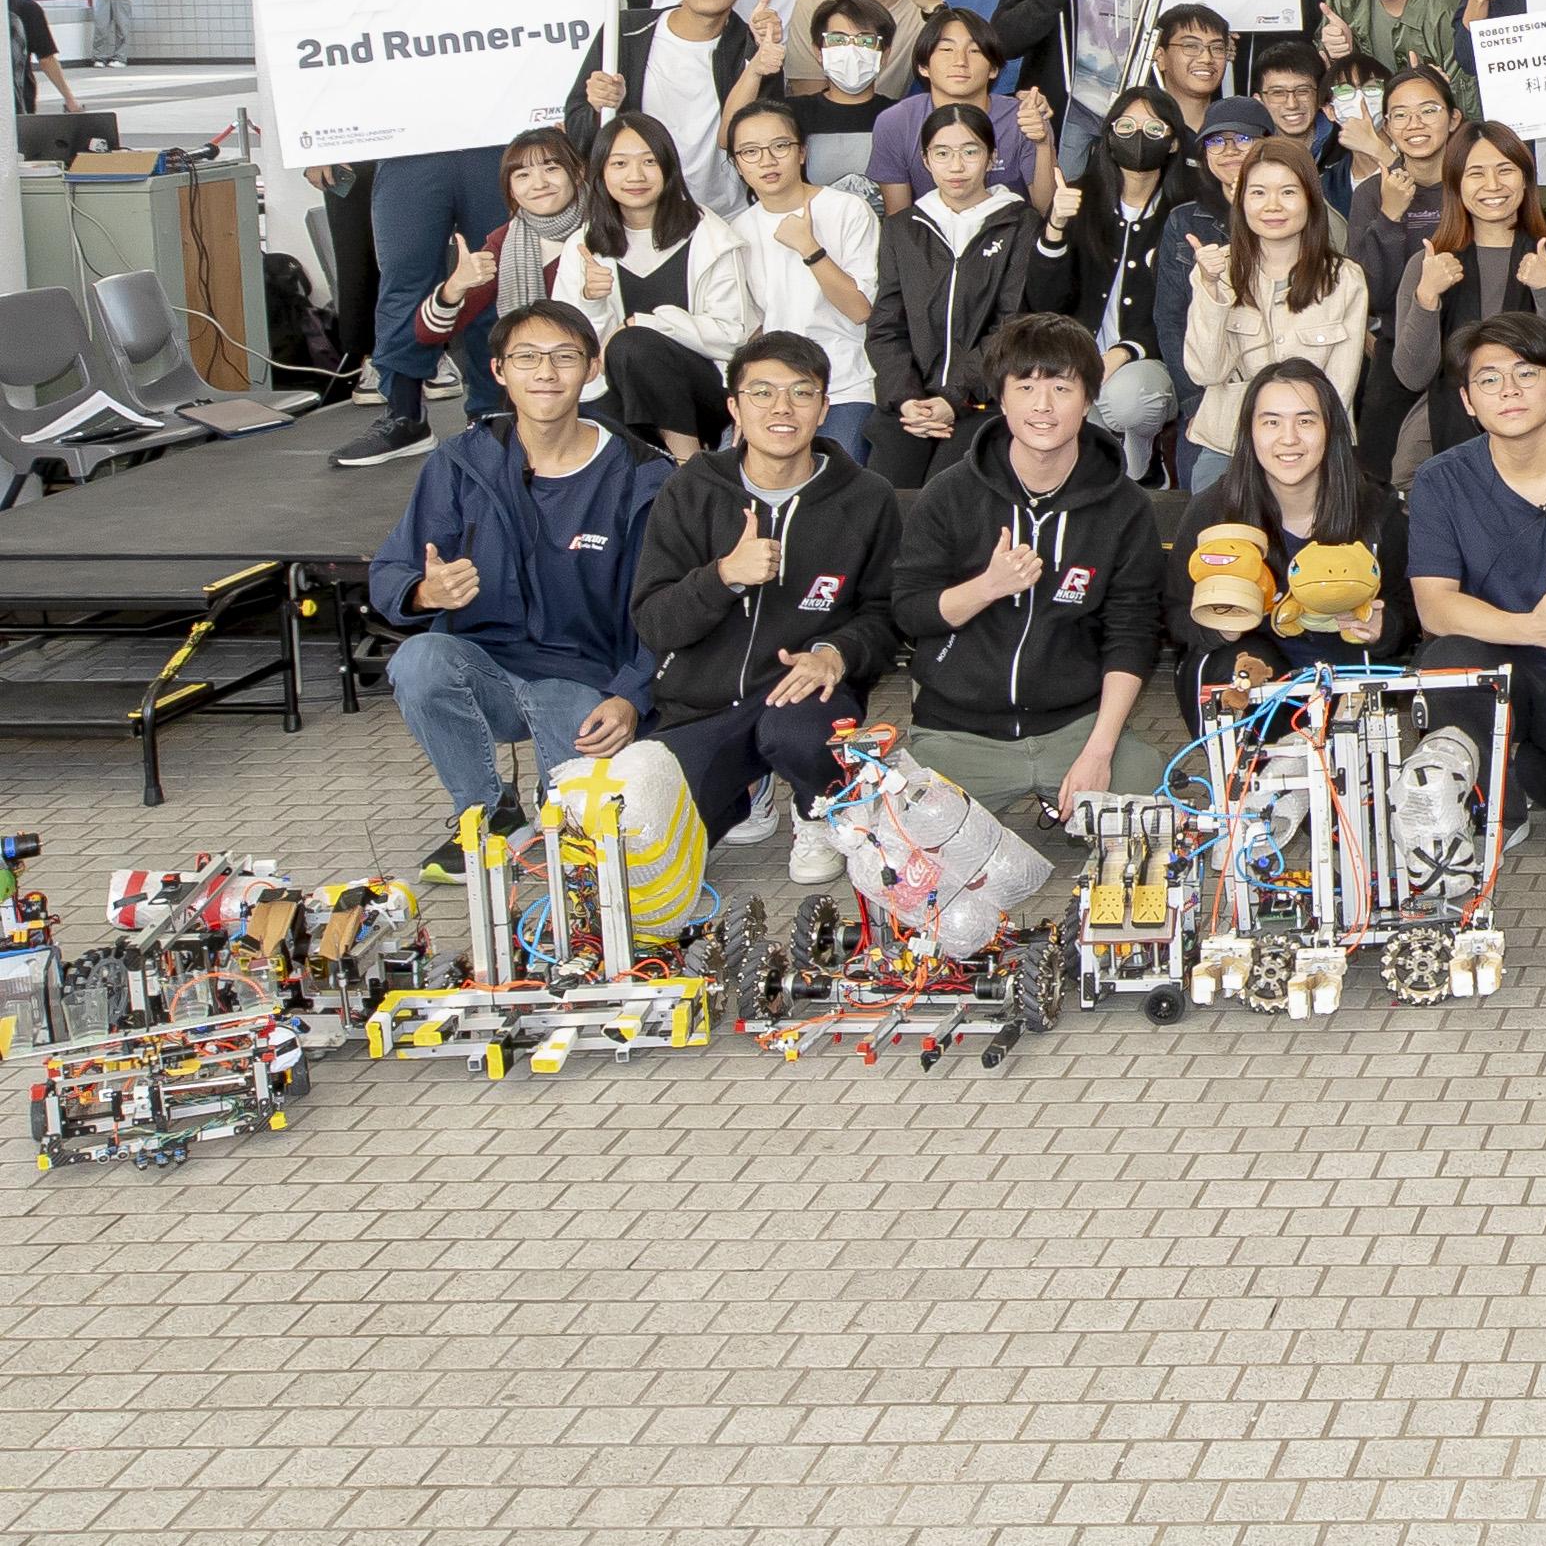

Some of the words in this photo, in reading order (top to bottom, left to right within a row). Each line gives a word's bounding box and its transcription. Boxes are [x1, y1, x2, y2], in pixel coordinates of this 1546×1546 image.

[1479, 26, 1510, 38] ROBOT
[1513, 21, 1546, 33] DESIGN
[296, 36, 374, 70] 2nd
[383, 19, 590, 60] Runner-up
[1480, 36, 1523, 48] CONTEST
[1488, 58, 1529, 74] FROM
